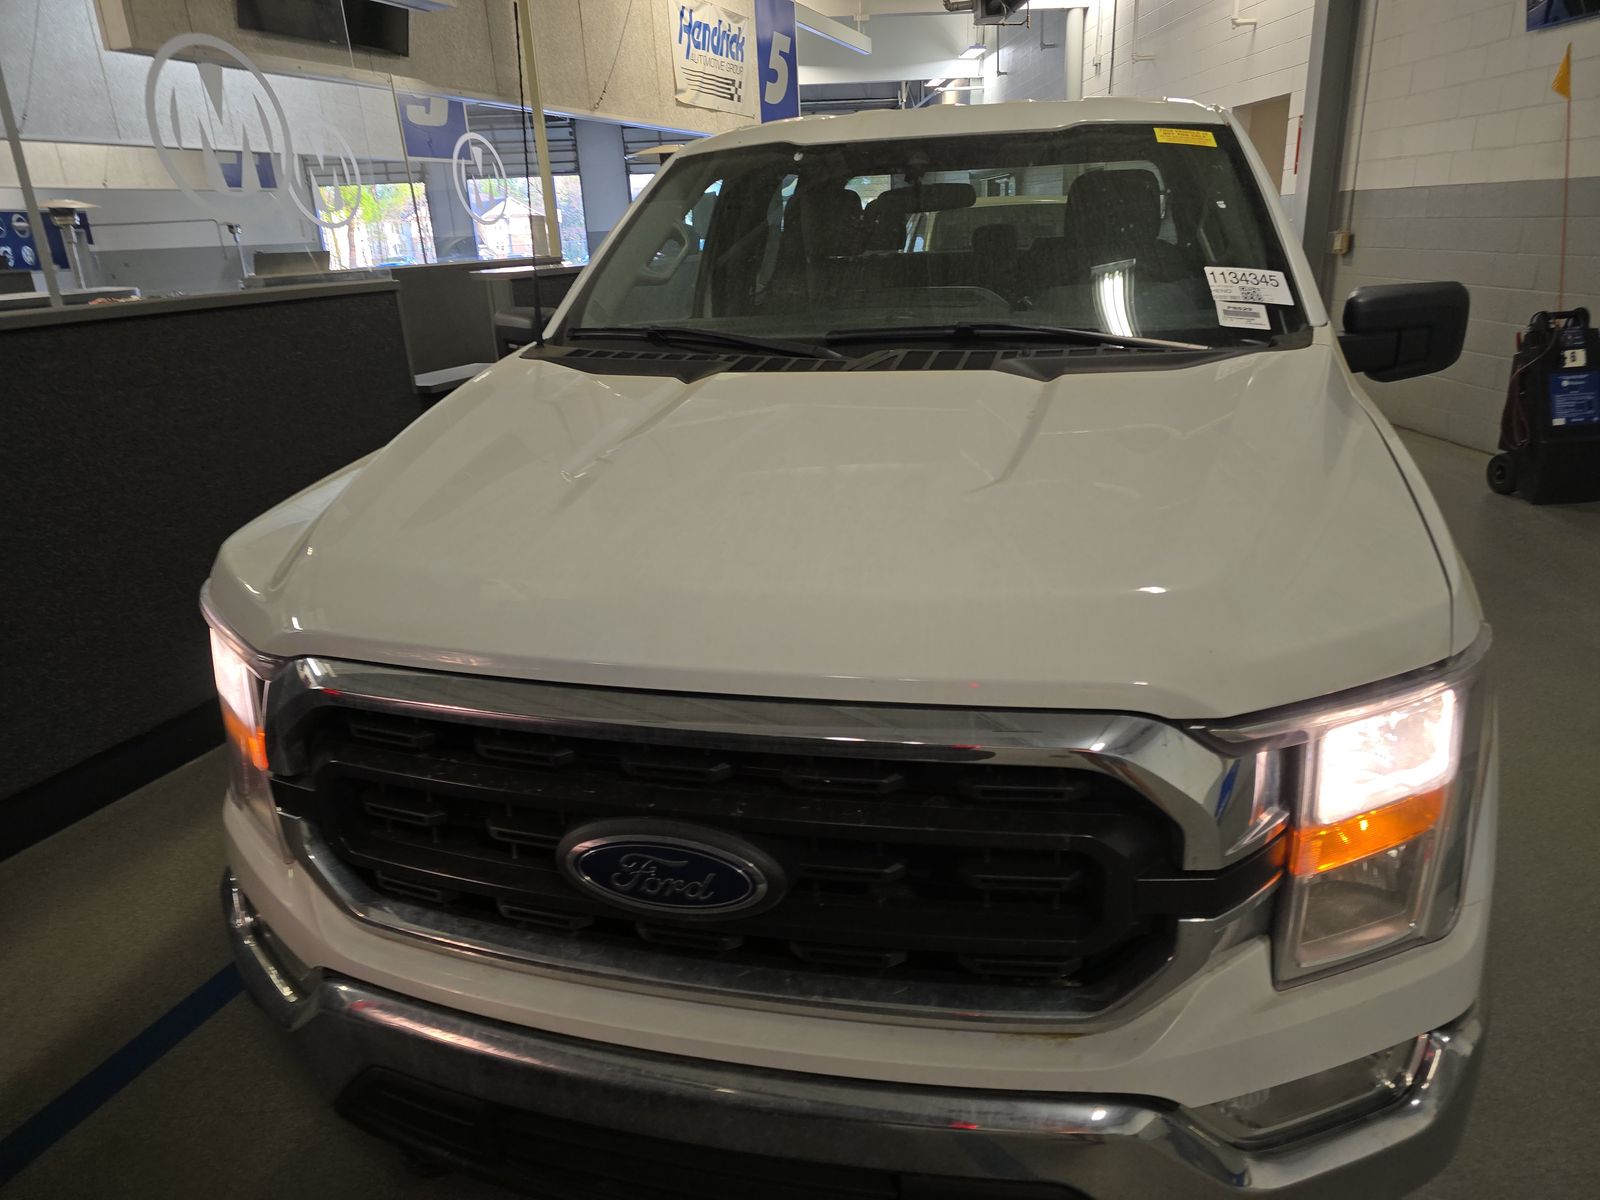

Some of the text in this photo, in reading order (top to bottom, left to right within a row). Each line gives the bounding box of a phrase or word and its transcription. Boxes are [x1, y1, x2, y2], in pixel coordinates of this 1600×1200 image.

[678, 5, 745, 62] Hendrick
[689, 53, 743, 75] AUTOMOTIVE GROUP
[764, 31, 791, 104] 5
[1209, 271, 1280, 288] 1134345
[611, 853, 717, 900] Ford
